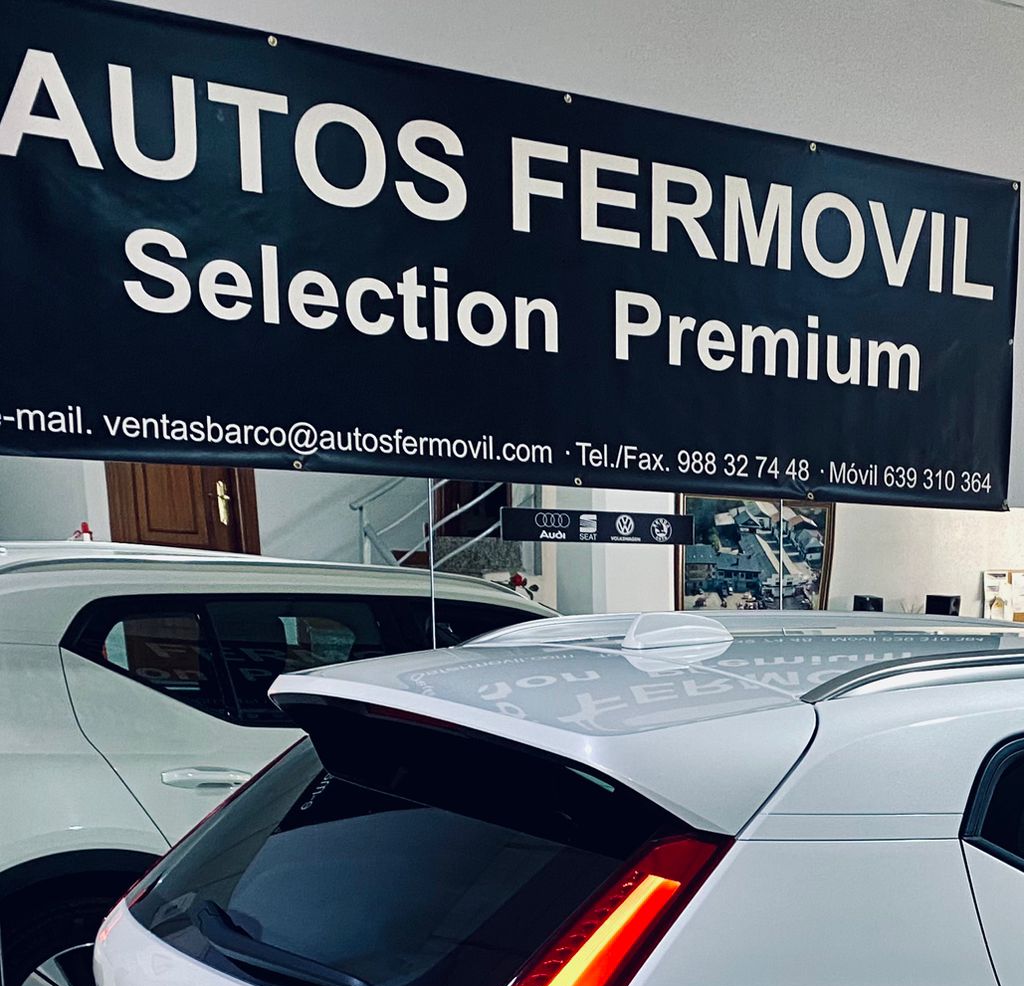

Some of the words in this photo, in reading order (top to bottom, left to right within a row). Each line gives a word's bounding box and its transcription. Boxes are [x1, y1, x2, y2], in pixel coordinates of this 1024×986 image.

[0, 48, 468, 222] AUTOS
[511, 136, 995, 302] FERMOVIL
[123, 229, 559, 354] Selection
[614, 290, 922, 392] Premium
[102, 414, 553, 469] ventasbarco@autosfermovil.com
[576, 441, 670, 475] Tel./Fax.
[677, 449, 718, 475] 988
[723, 453, 749, 478] 32
[755, 455, 780, 480] 74
[785, 458, 810, 482] 48
[829, 461, 879, 487] Móvil
[883, 465, 918, 490] 639
[922, 468, 956, 491] 310
[960, 471, 992, 494] 364
[540, 529, 567, 540] Audi
[579, 532, 598, 541] SEAT
